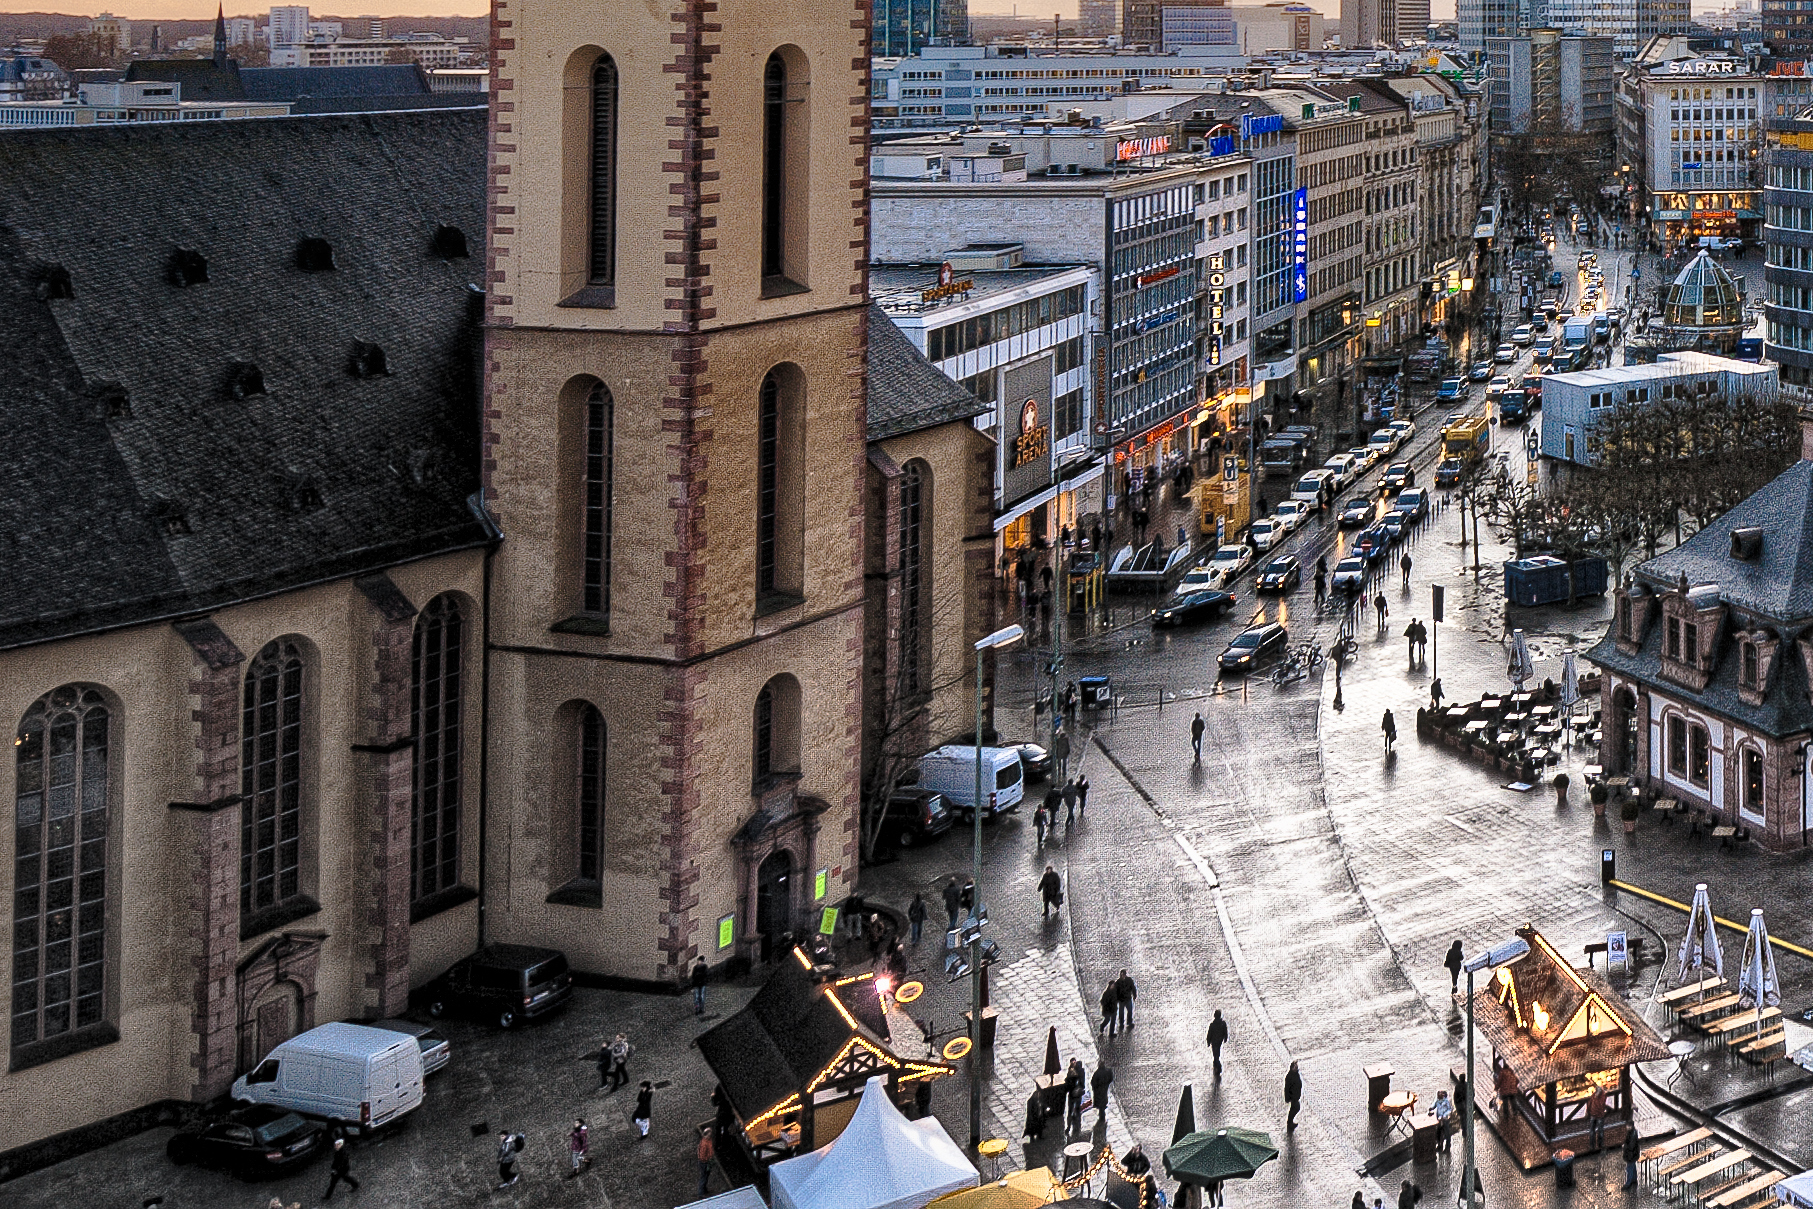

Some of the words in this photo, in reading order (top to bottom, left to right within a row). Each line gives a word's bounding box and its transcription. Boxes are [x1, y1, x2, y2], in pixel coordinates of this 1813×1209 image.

[1668, 61, 1734, 74] SARAR
[1769, 61, 1804, 76] JVC
[1210, 256, 1224, 336] HOTEL
[1016, 425, 1048, 447] SPORT
[1015, 439, 1047, 468] ARENA
[1225, 469, 1234, 480] U
